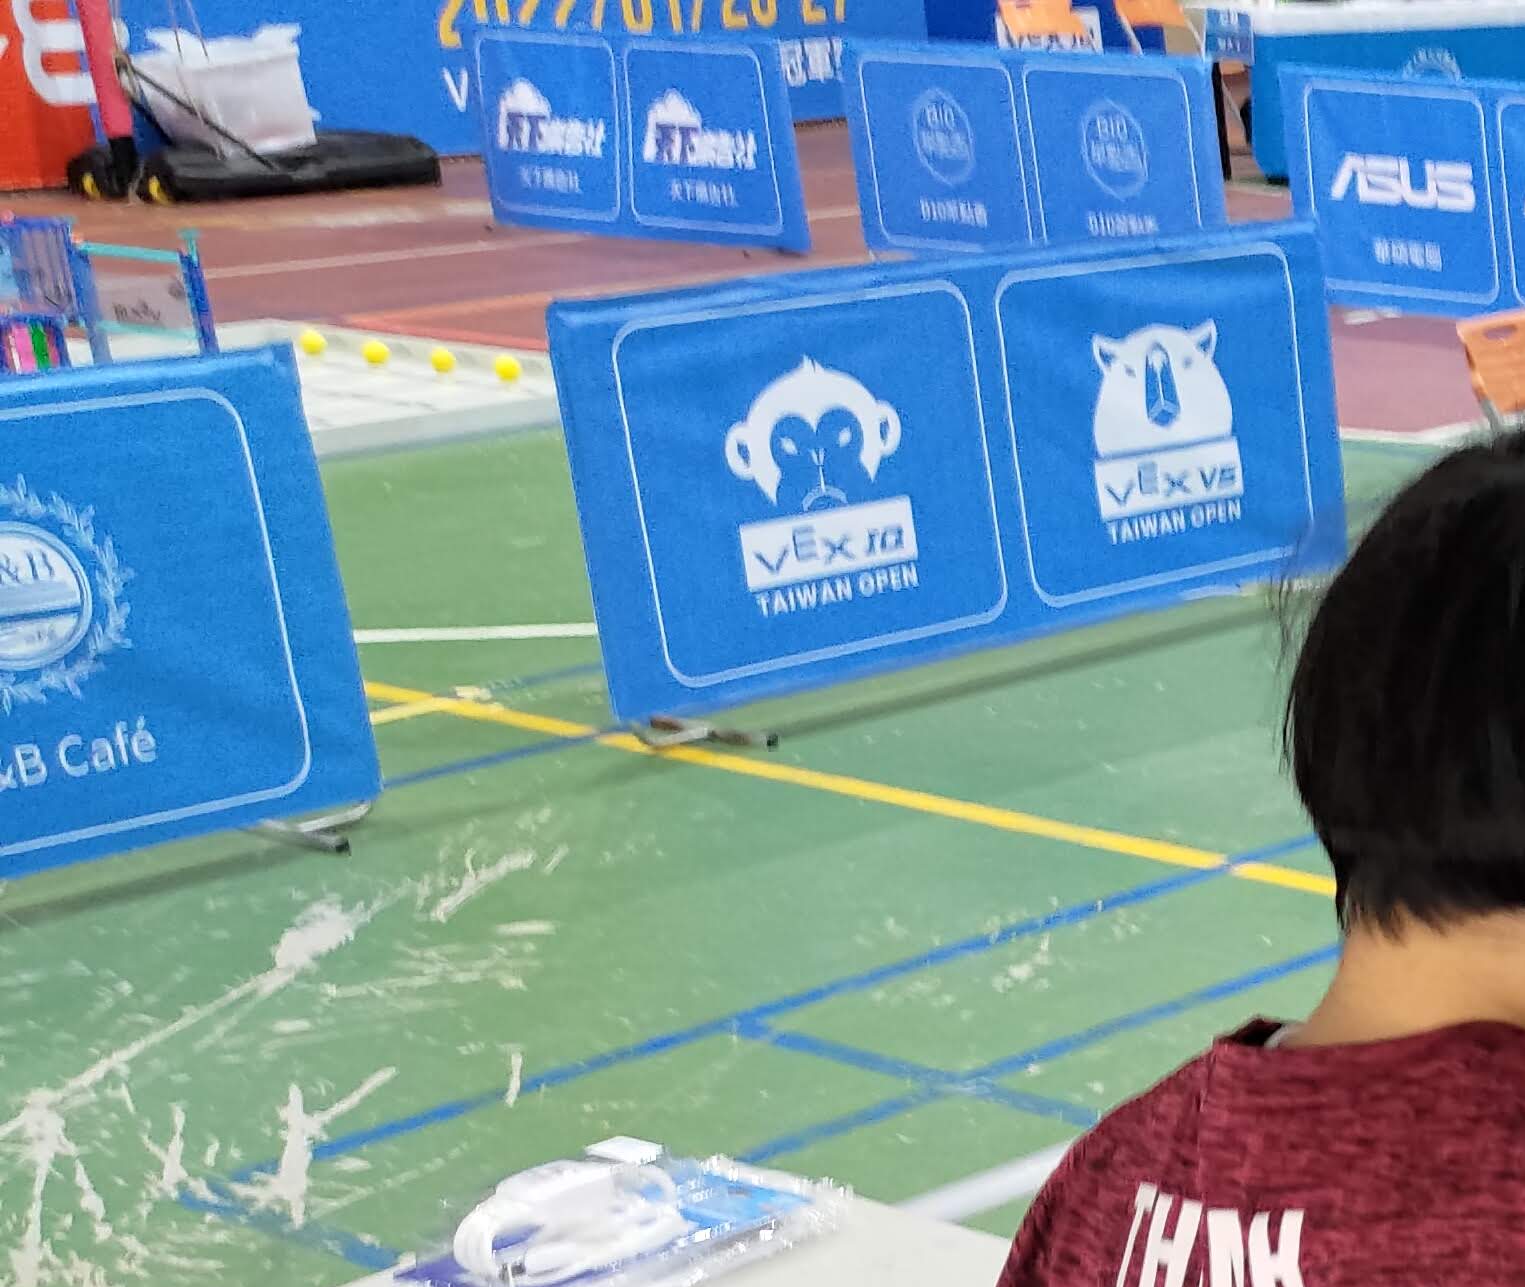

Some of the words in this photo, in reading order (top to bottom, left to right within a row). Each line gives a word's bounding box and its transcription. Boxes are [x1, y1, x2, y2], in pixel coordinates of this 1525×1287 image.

[1331, 152, 1475, 213] ASUS
[1107, 506, 1187, 545] TAIWAN
[1191, 496, 1242, 529] OPEN
[756, 573, 853, 618] TAIWAN
[858, 559, 919, 598] OPEN
[57, 714, 157, 777] Café
